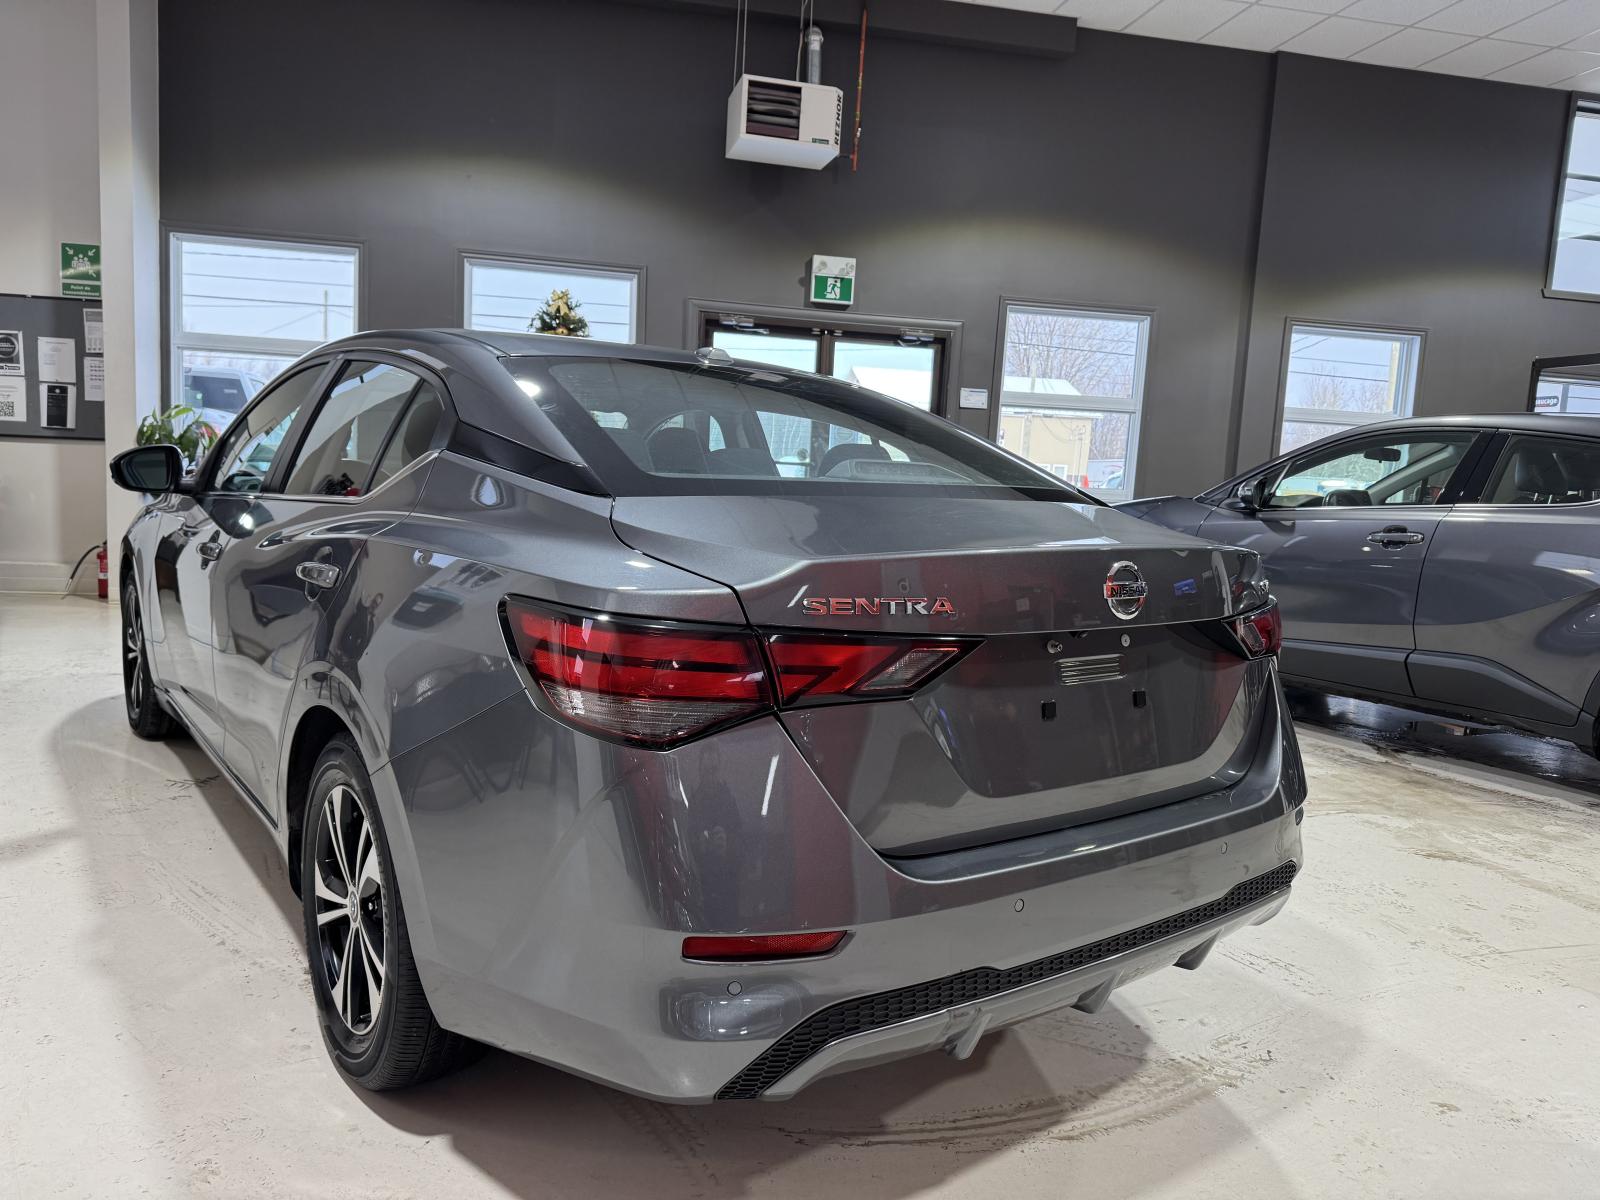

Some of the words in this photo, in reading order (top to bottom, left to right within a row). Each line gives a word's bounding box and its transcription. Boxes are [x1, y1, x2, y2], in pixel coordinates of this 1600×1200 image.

[834, 94, 842, 145] REZNOR
[1110, 584, 1146, 597] NISSAN
[802, 596, 956, 616] SENTRA
